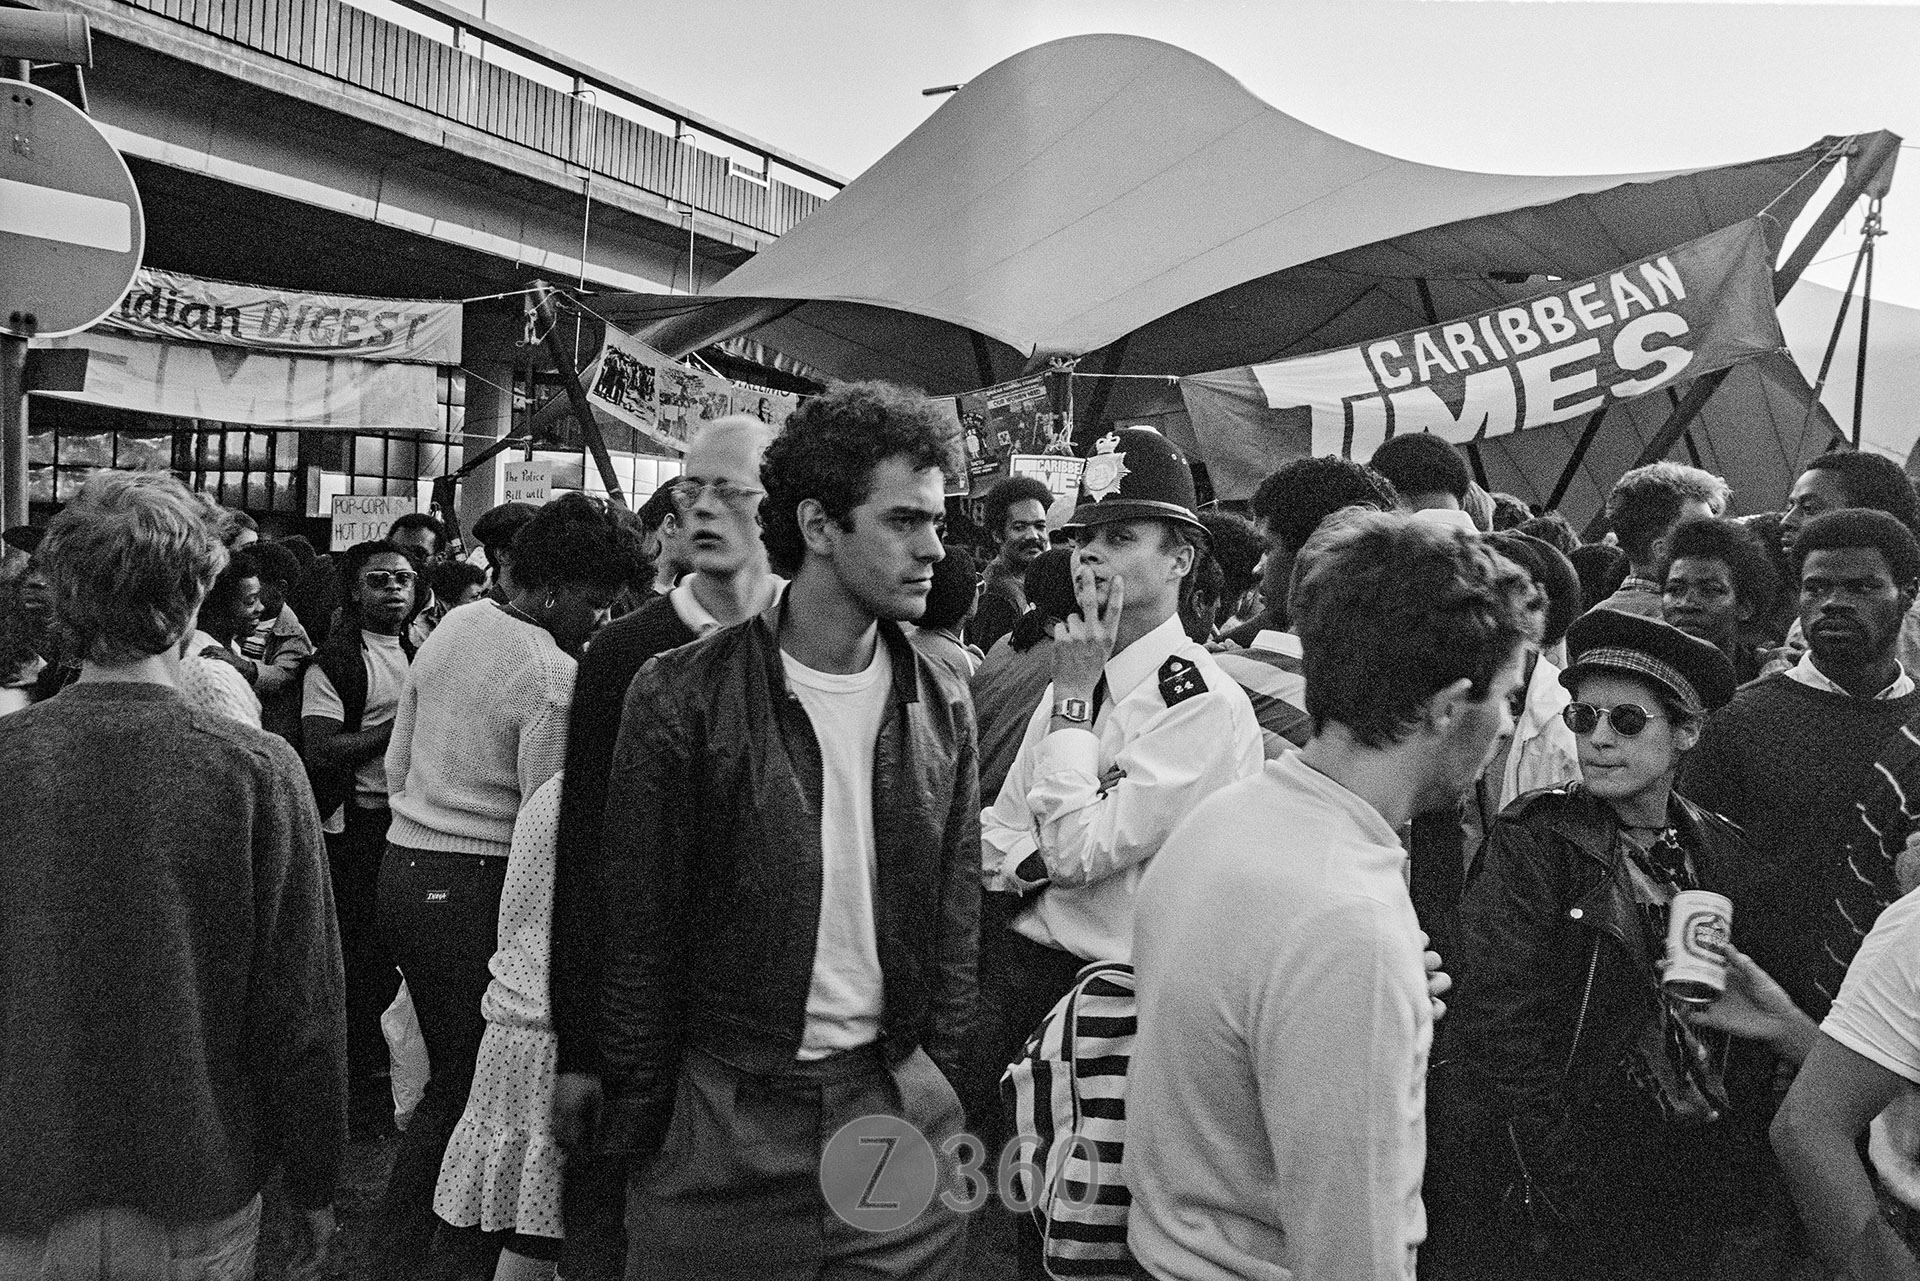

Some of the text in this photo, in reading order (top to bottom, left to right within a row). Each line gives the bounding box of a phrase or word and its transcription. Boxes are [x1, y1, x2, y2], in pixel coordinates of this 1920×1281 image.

[259, 300, 427, 350] DIGEST
[1367, 256, 1687, 389] CARIBBEAN
[1252, 311, 1694, 466] TIMES
[522, 469, 544, 482] Police
[1038, 460, 1084, 475] CARIBBE
[505, 488, 544, 500] Bill will
[334, 523, 357, 541] HOT
